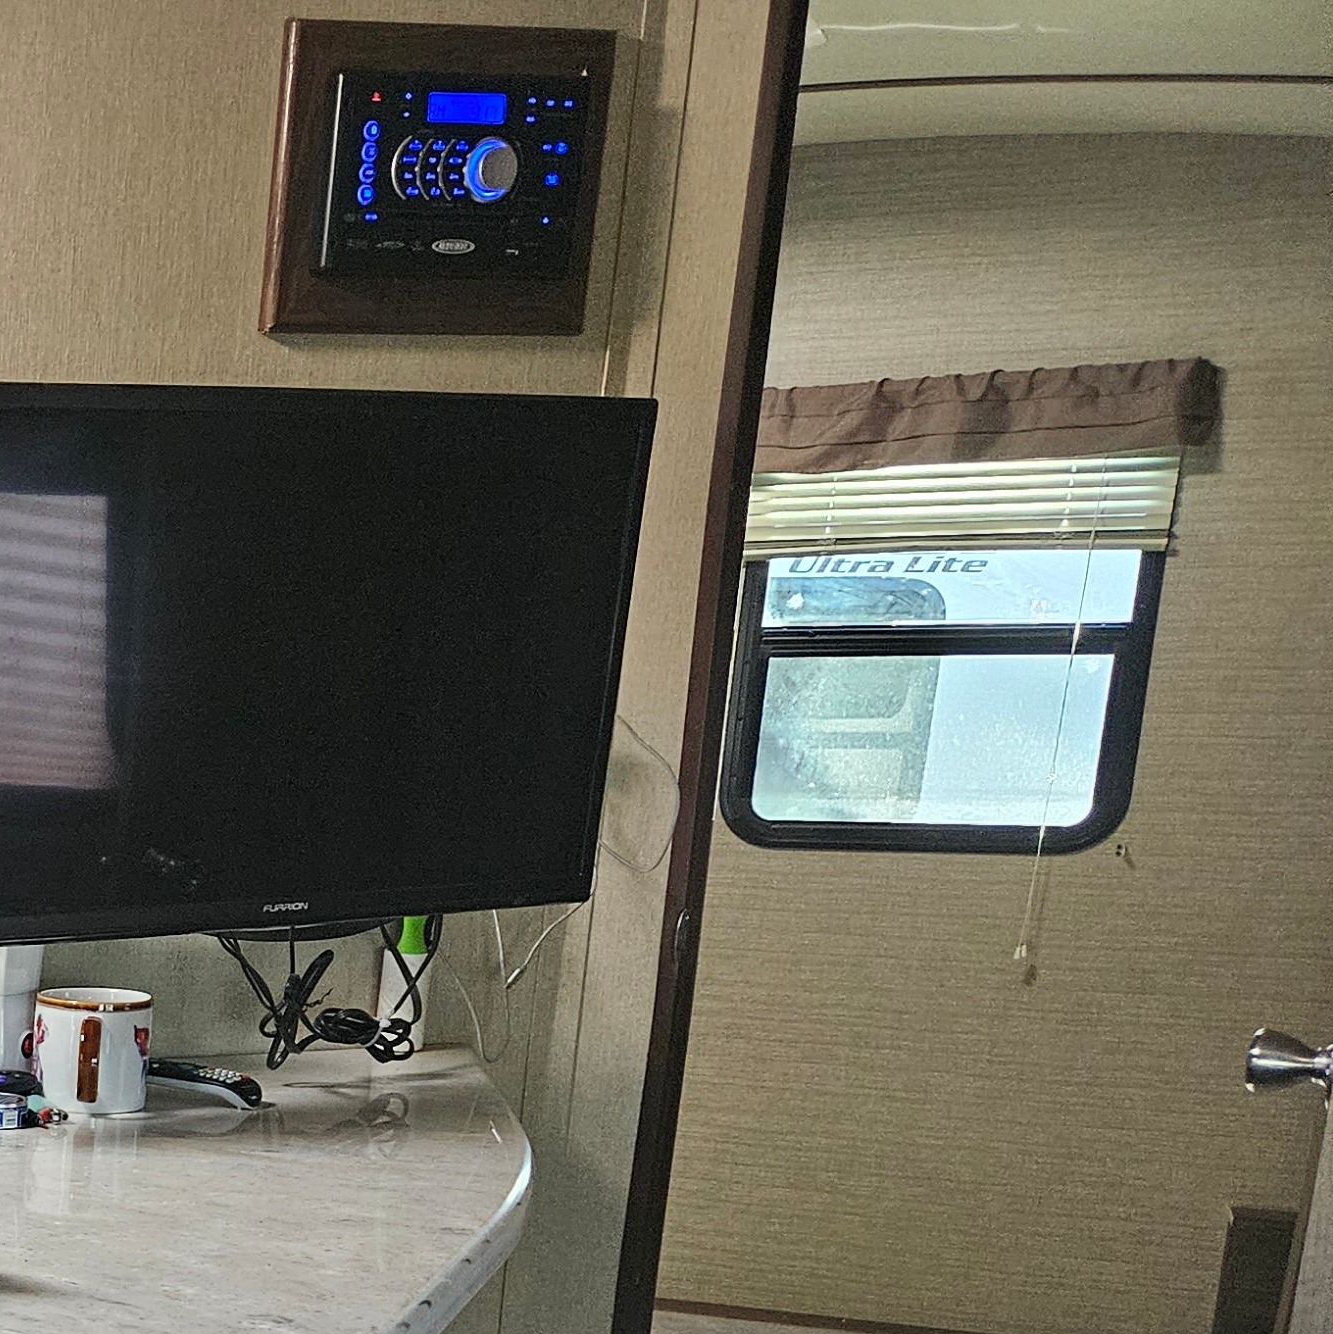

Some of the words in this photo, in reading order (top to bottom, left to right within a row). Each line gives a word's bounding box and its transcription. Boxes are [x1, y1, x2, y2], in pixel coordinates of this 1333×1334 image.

[788, 556, 895, 574] Ultra
[903, 556, 989, 573] Lite
[262, 902, 309, 913] FURRION
